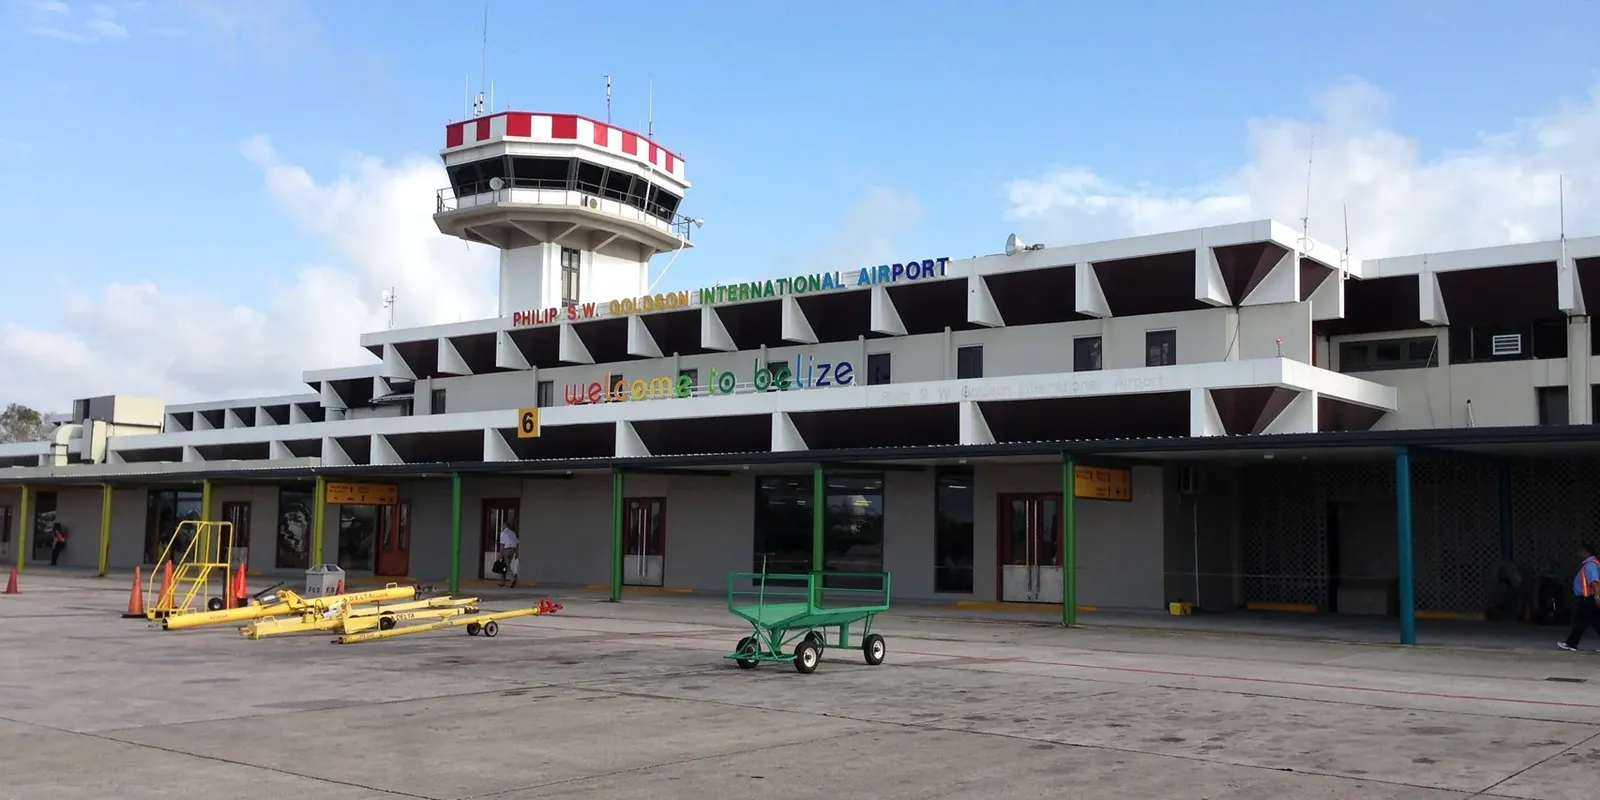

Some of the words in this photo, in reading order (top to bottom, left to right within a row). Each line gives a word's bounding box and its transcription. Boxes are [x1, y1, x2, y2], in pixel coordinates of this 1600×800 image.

[513, 307, 558, 327] PHILIP
[609, 290, 690, 316] GOLDSON
[700, 272, 846, 304] INTERNATIONAL
[857, 257, 950, 286] AIRPORT
[564, 370, 693, 405] welcome
[708, 367, 737, 396] to
[753, 353, 853, 391] belize
[522, 411, 534, 434] 6
[349, 593, 372, 602] DELTA
[396, 613, 415, 621] DELTA
